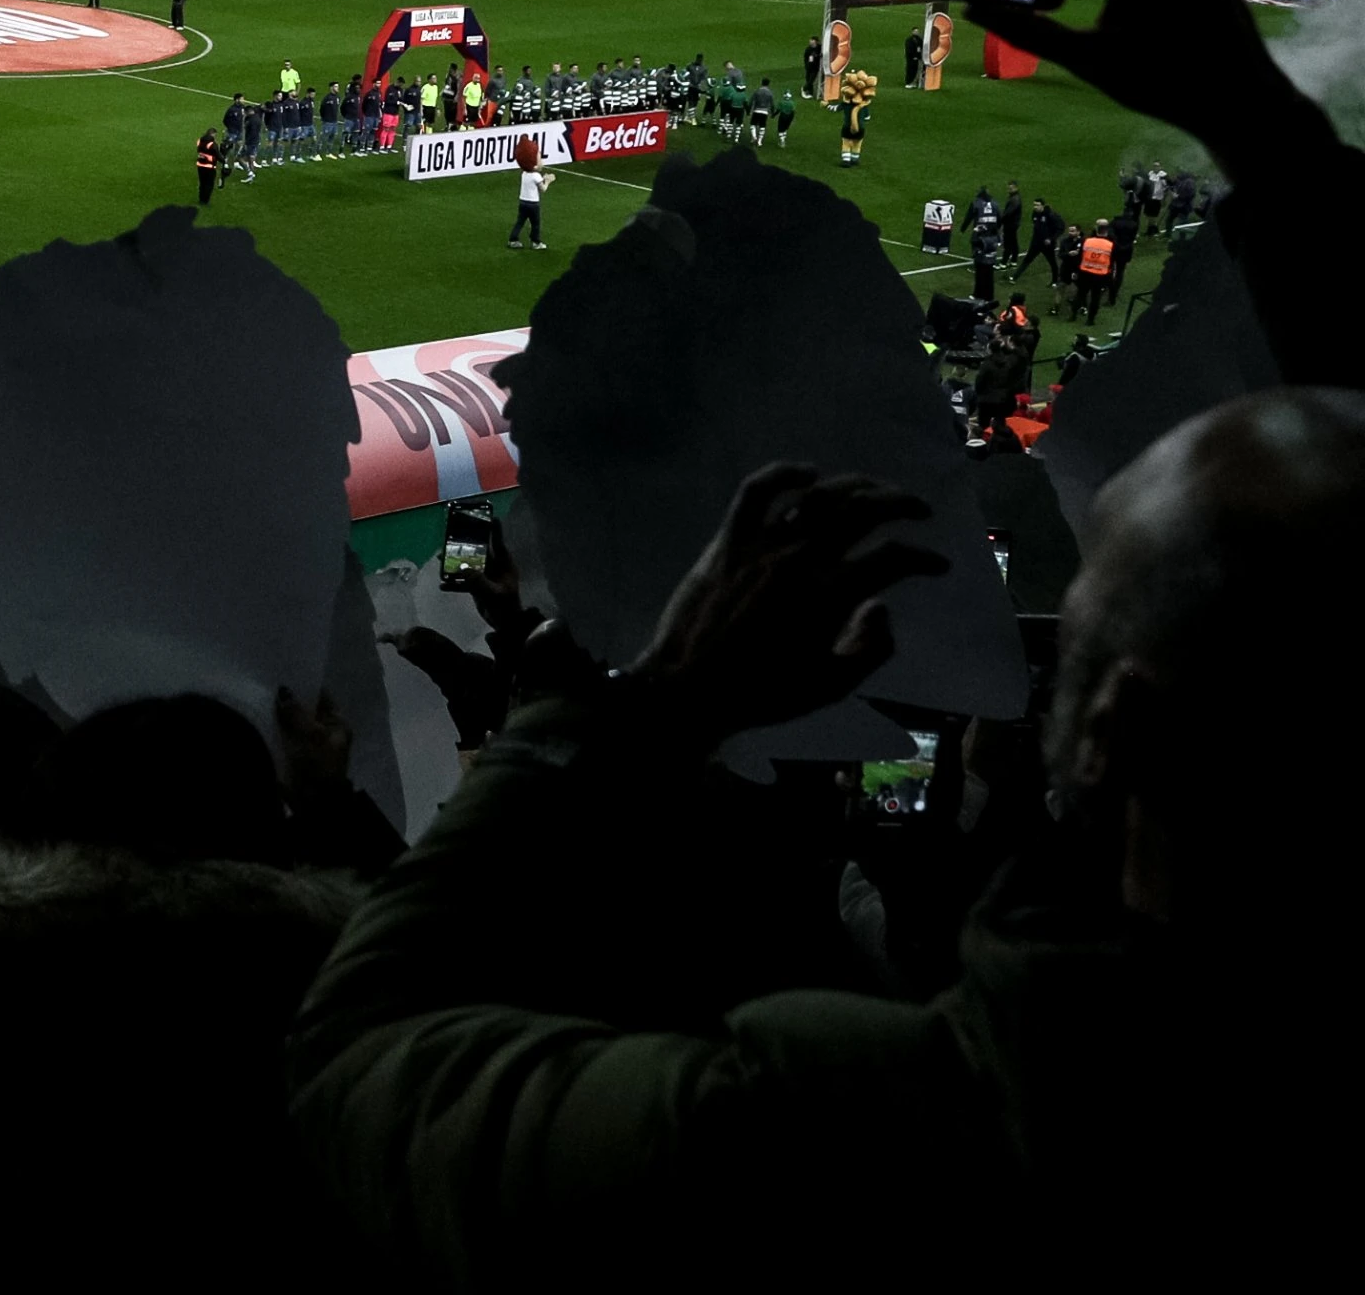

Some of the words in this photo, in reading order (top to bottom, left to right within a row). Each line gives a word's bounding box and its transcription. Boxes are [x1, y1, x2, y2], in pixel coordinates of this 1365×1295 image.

[420, 27, 453, 42] Betclic
[417, 140, 455, 174] LIGA
[462, 131, 549, 169] PORTUL
[584, 118, 660, 154] Betclic
